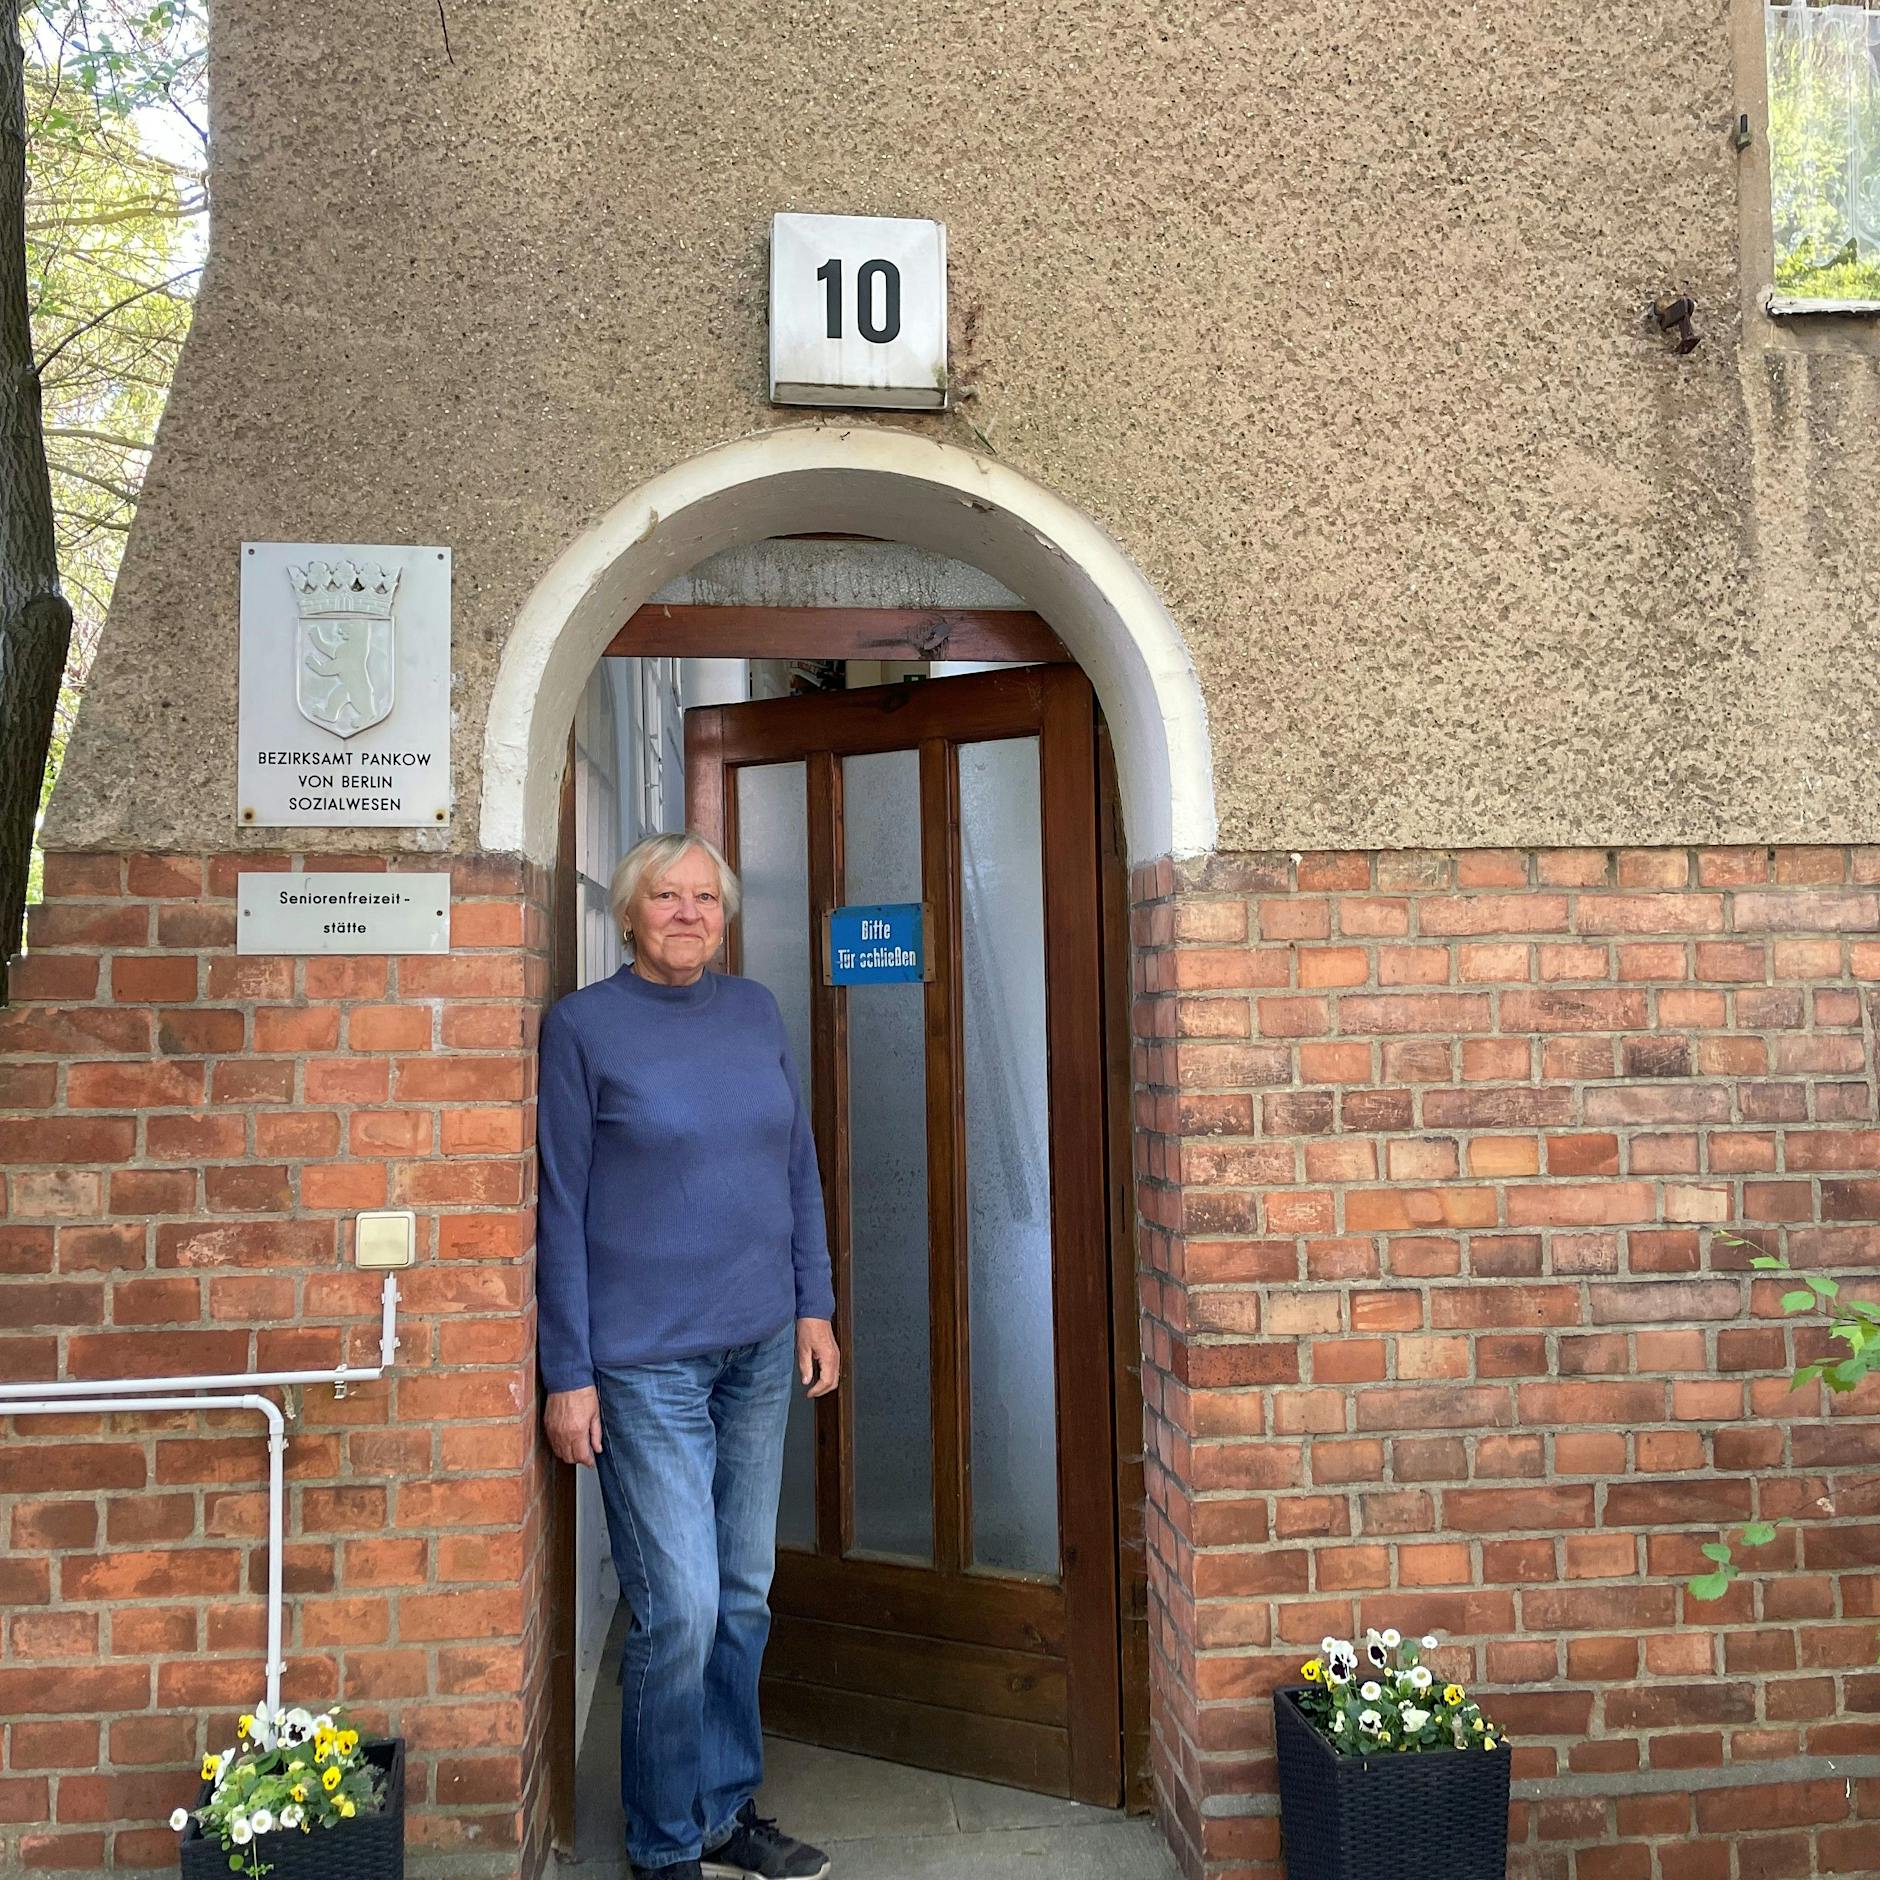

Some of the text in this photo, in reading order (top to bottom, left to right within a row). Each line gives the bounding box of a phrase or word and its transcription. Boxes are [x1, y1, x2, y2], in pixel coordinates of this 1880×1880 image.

[816, 258, 901, 344] 10
[258, 751, 431, 766] BEZIRKSAMT PANKOW
[298, 775, 393, 788] VON BERLIN
[289, 797, 401, 811] SOZIALWESEN
[323, 922, 367, 934] stätte
[861, 919, 891, 941] Bitte
[837, 946, 917, 969] Tür schließen
